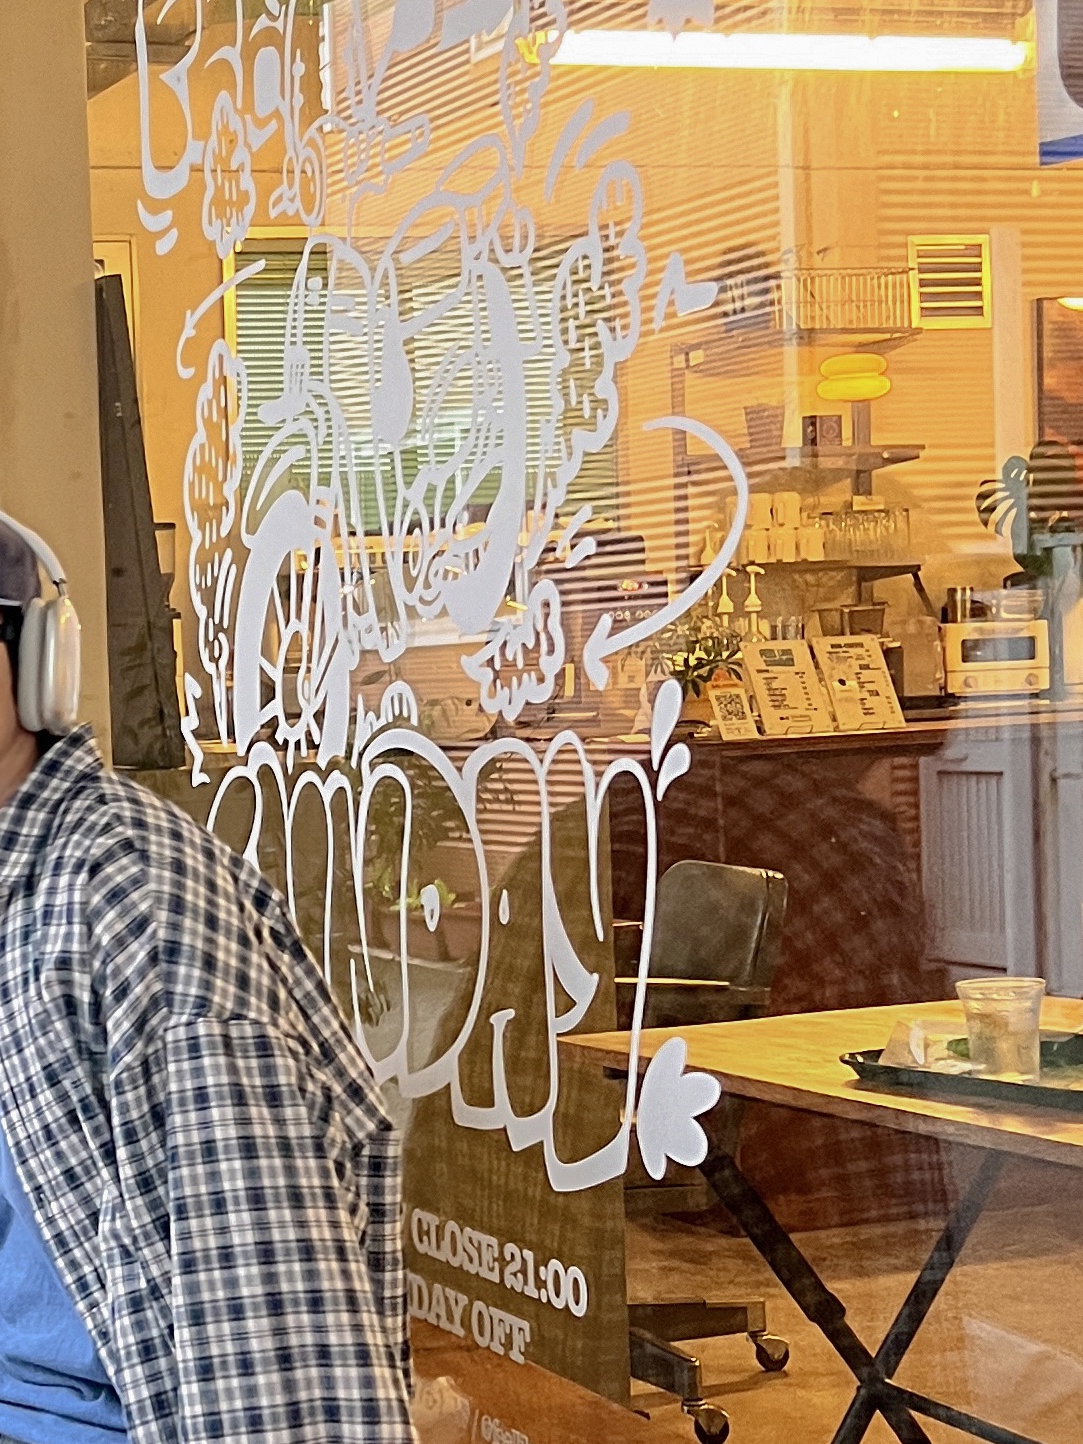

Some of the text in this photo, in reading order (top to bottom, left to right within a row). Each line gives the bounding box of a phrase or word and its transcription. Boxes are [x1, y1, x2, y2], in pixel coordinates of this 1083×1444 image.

[410, 1208, 588, 1318] CLOSE 21:00
[407, 1269, 531, 1365] DAY OFF
